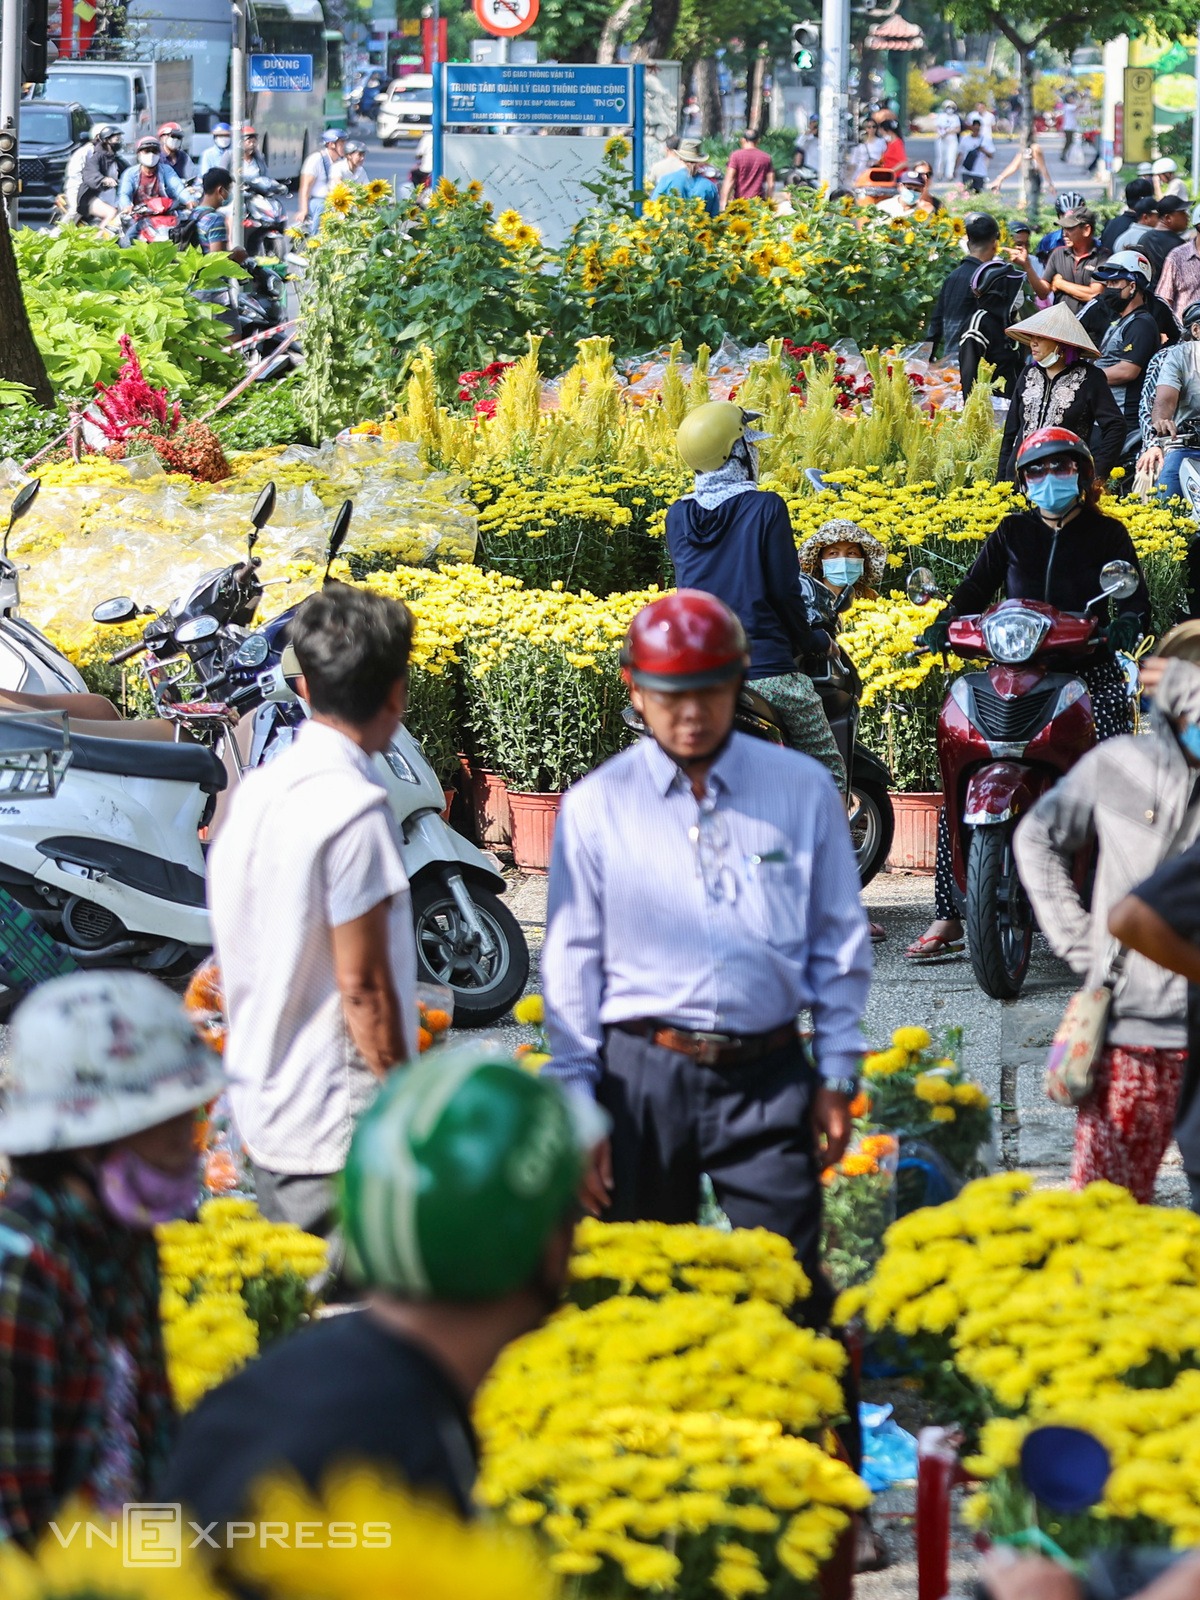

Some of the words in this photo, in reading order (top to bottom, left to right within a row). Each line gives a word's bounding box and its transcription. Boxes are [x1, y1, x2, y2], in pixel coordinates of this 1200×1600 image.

[263, 58, 300, 69] ĐƯỜNG
[252, 72, 278, 87] NGUYỄN
[512, 70, 528, 78] GIAO
[529, 70, 549, 79] THÔNG
[451, 82, 477, 93] TRUNG
[479, 81, 496, 93] TÂM
[497, 81, 519, 93] QUẢN
[521, 82, 531, 93] LÝ
[532, 84, 551, 94] GIAO
[552, 83, 578, 94] THÔNG
[580, 83, 602, 94] CÔNG
[603, 83, 626, 95] CỘNG
